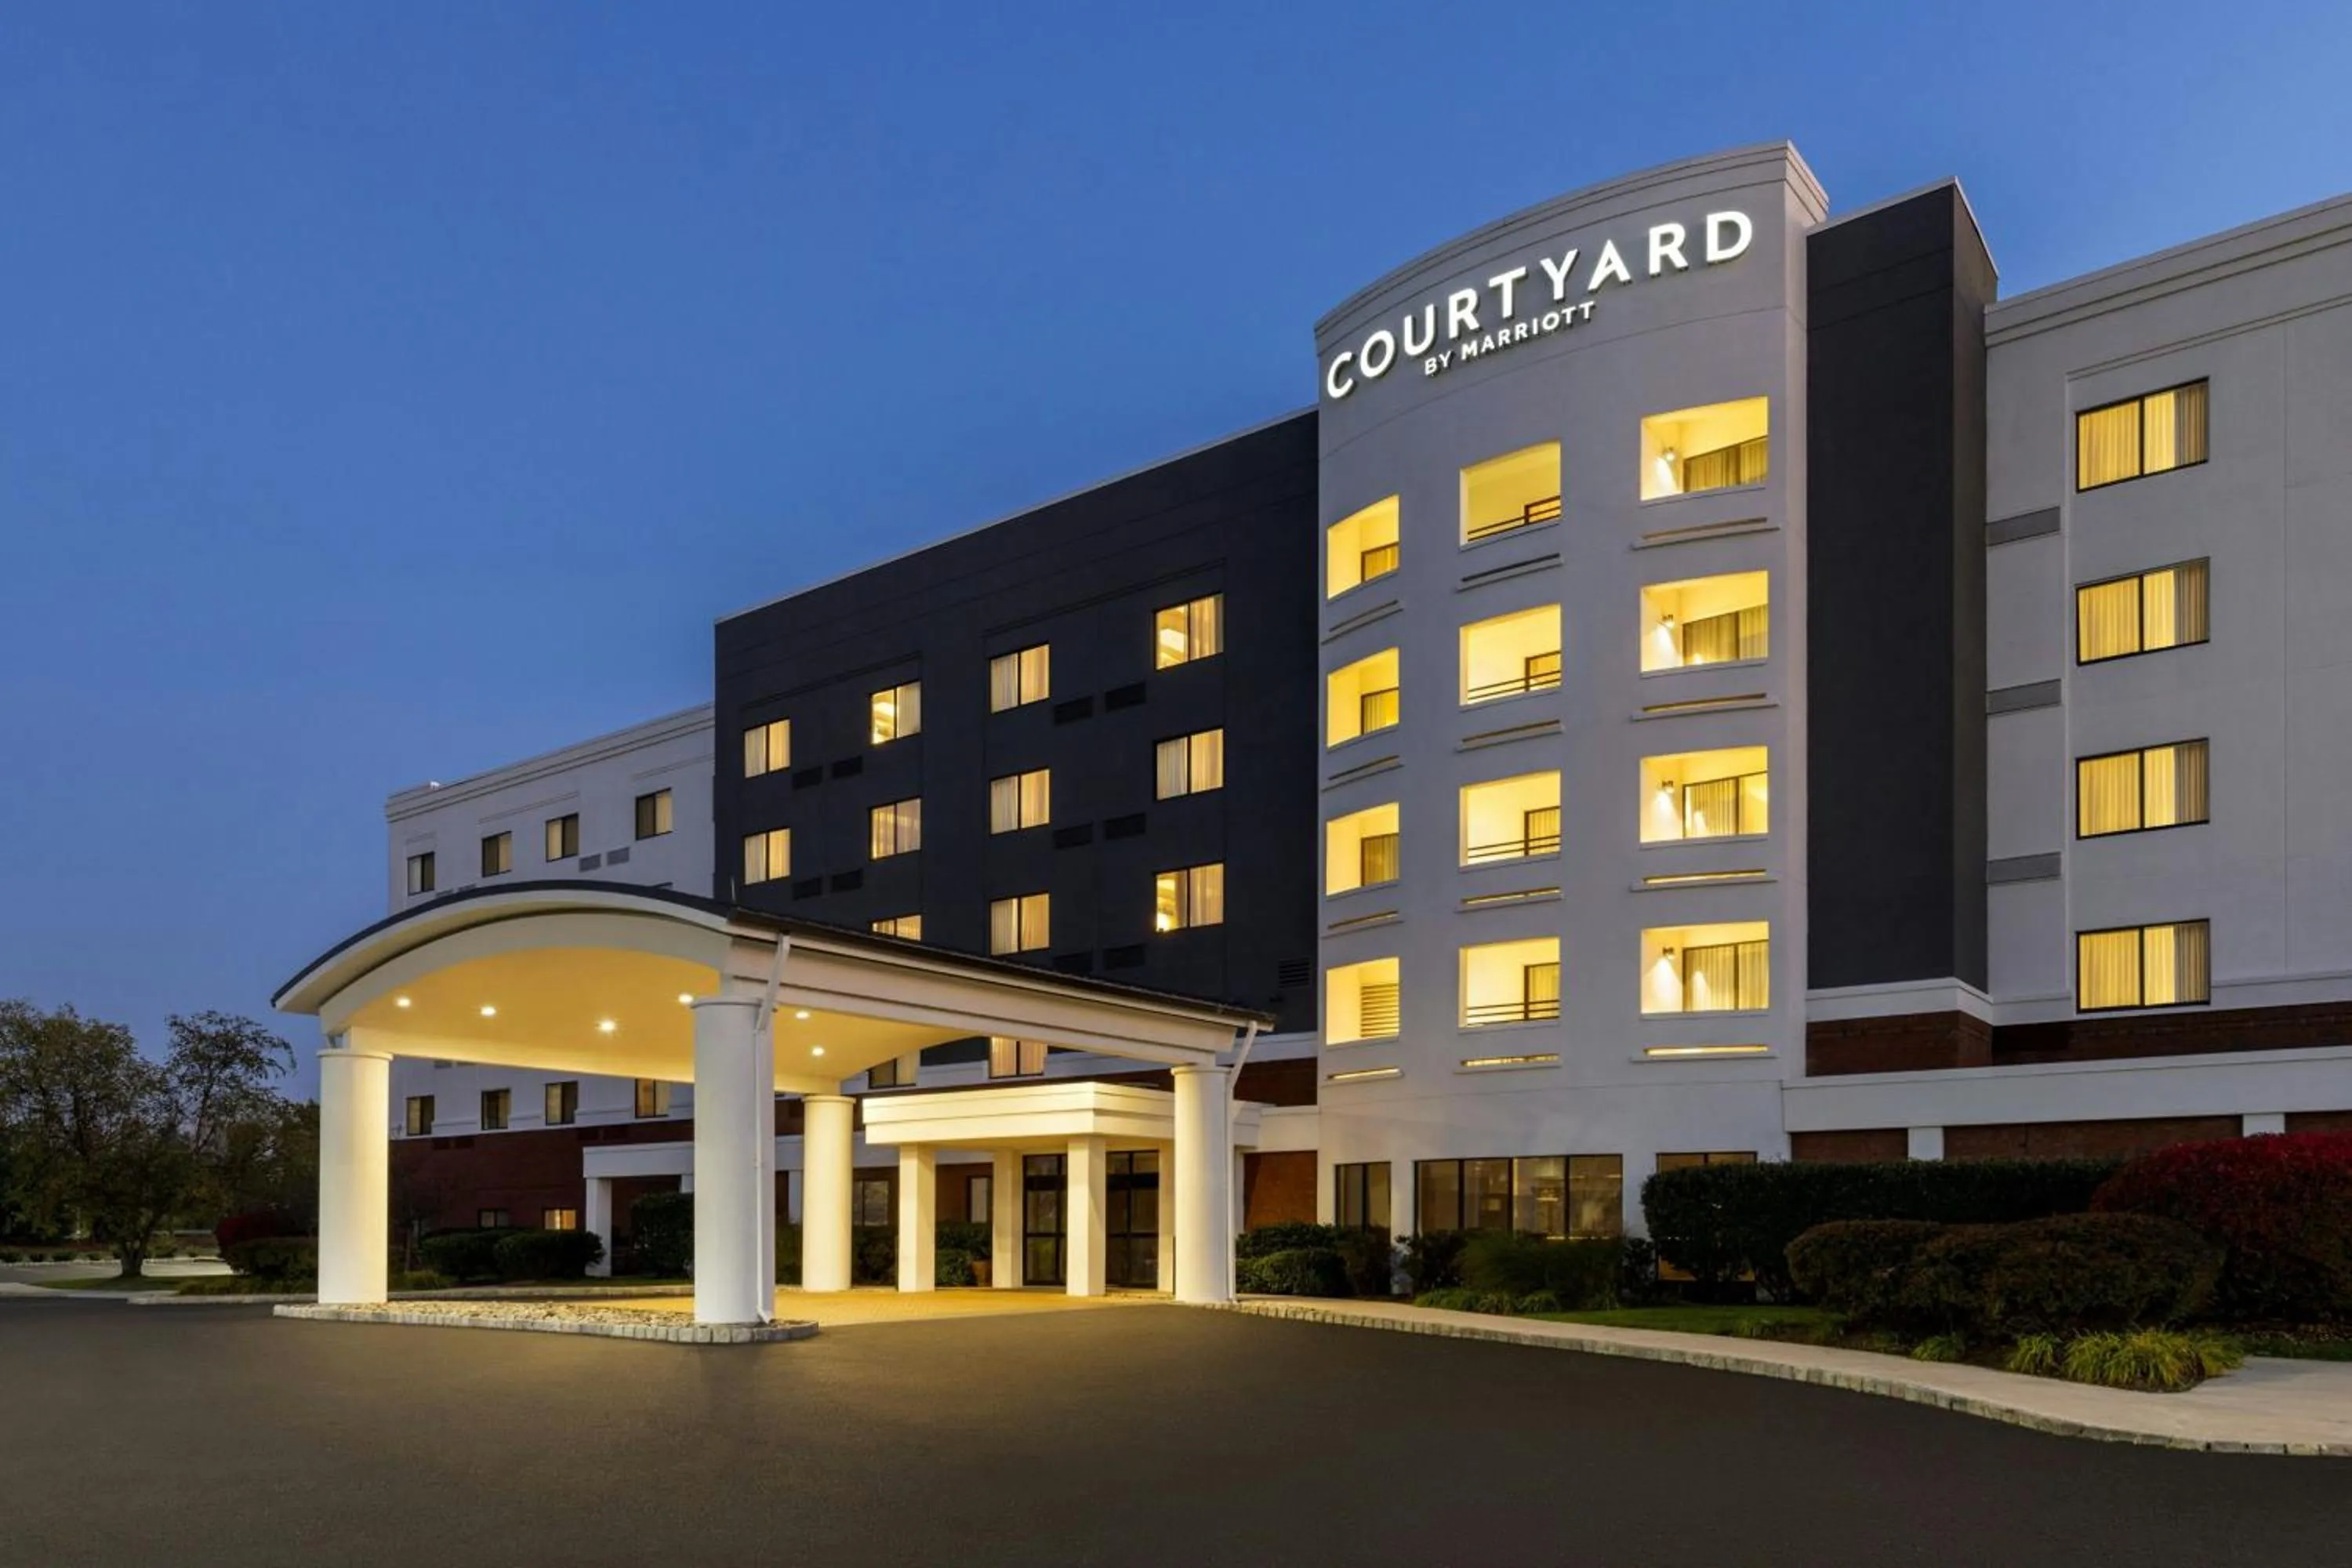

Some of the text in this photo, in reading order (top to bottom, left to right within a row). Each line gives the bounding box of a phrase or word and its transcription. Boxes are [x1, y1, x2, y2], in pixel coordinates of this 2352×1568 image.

[1327, 210, 1753, 399] COURTYARD
[1424, 300, 1595, 376] BY MARRIOTT
